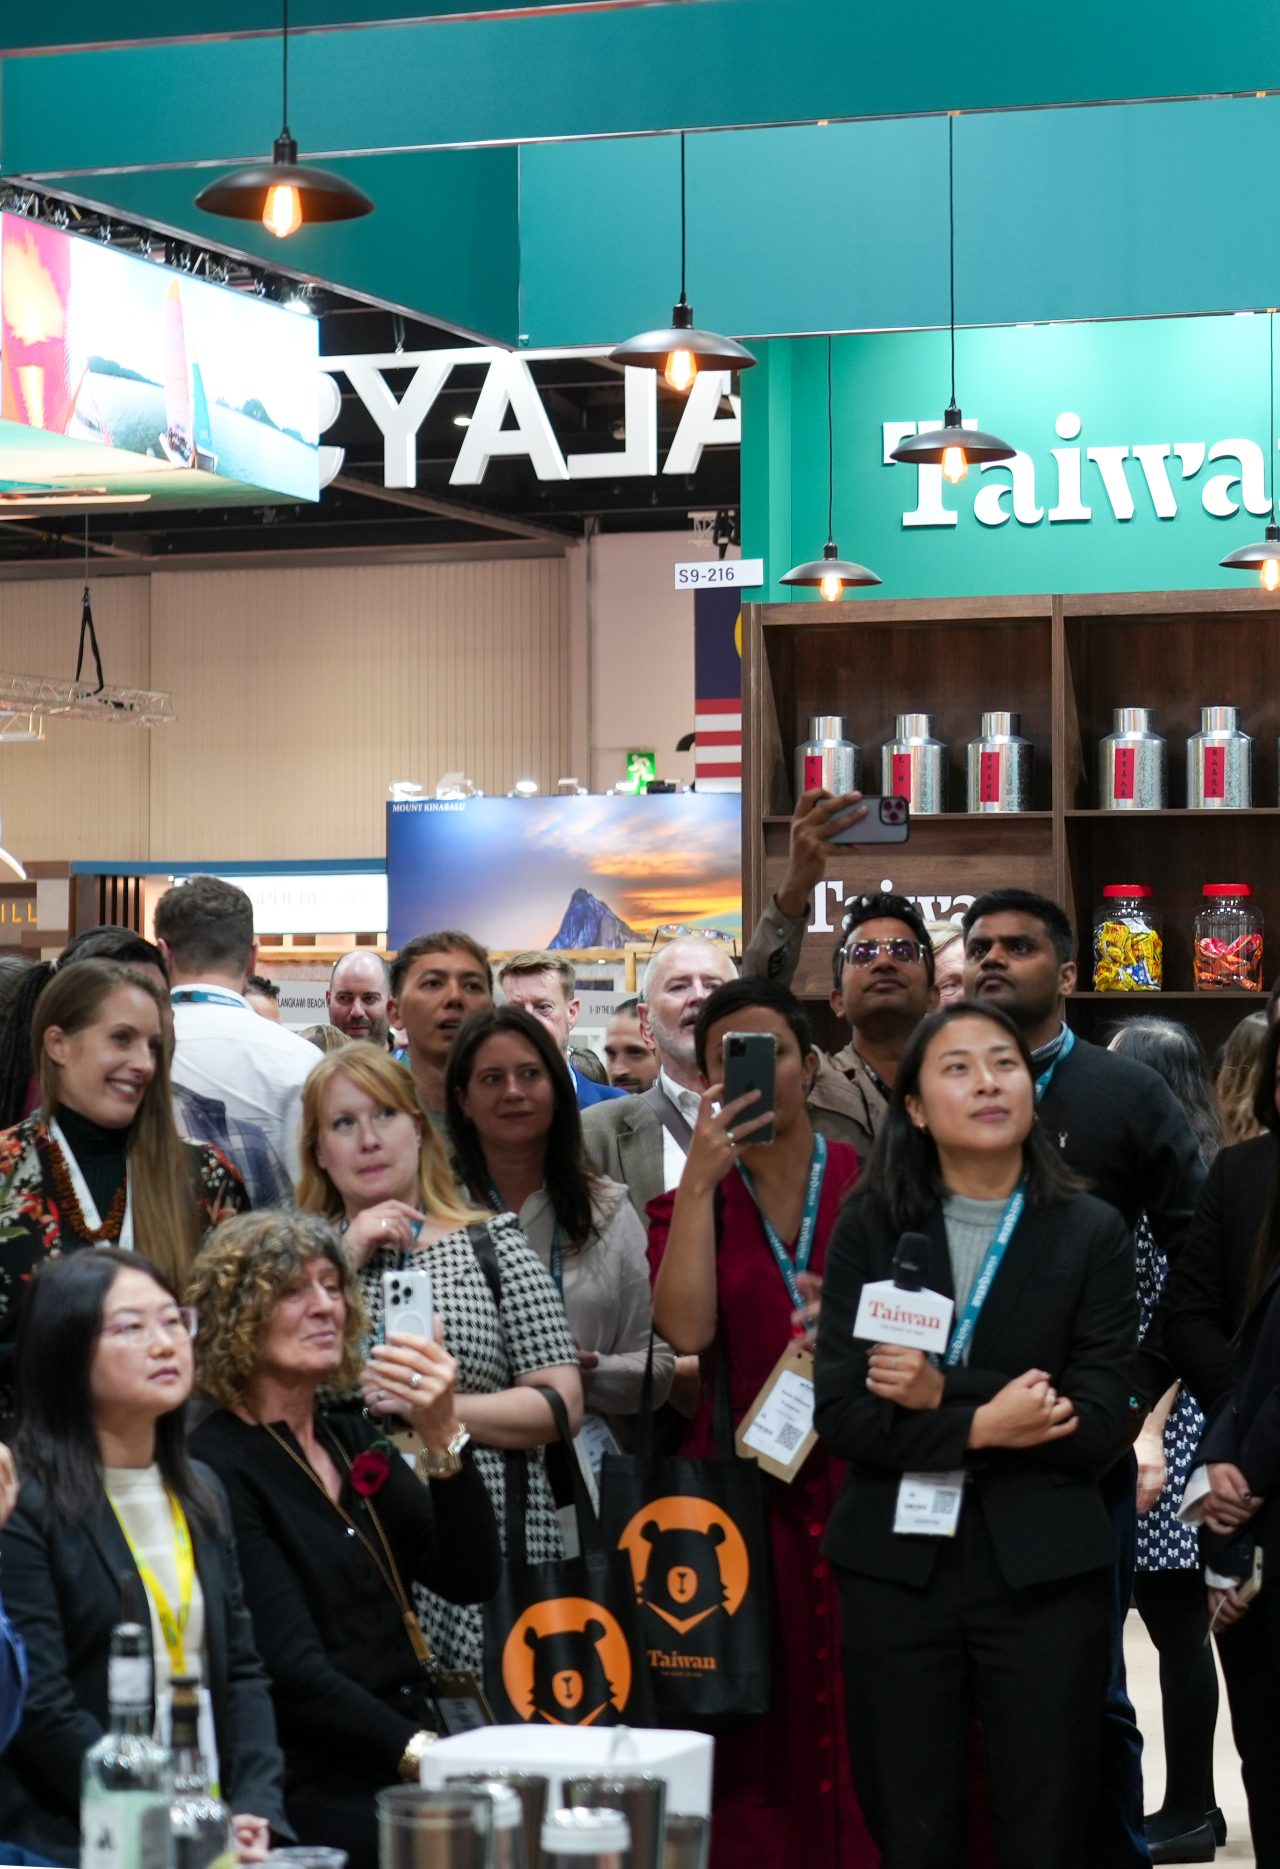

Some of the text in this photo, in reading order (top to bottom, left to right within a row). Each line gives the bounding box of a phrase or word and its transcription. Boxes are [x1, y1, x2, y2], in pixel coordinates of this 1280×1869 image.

[679, 567, 735, 583] S9-216
[392, 802, 465, 812] MOUNT KINABALU
[277, 997, 326, 1009] LANGKAWI BEACH
[868, 1300, 941, 1330] Taiwan
[646, 1650, 716, 1670] Taiwan
